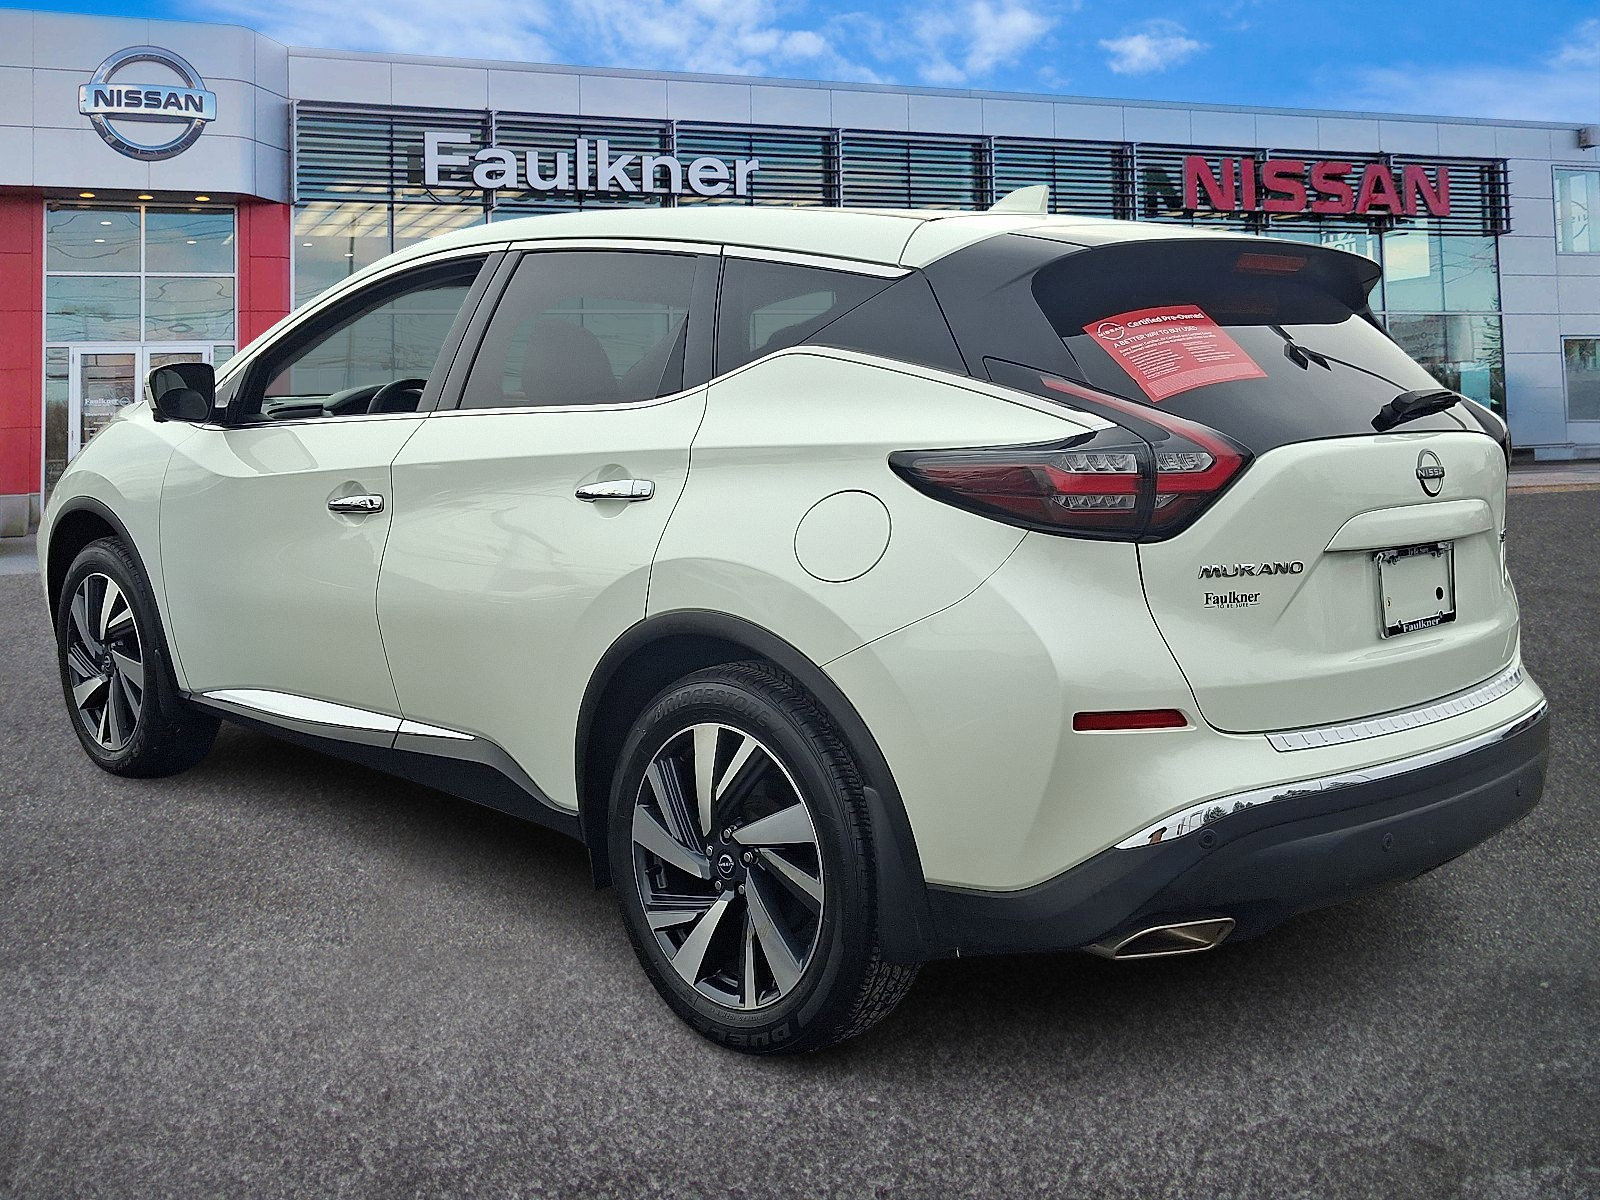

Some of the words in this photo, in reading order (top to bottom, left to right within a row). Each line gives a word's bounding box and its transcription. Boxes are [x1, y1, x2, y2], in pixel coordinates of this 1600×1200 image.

[94, 90, 203, 112] NISSAN
[424, 132, 759, 196] Faulkner
[1184, 155, 1450, 217] NISSAN
[1127, 317, 1162, 328] Certified
[1162, 312, 1205, 322] Pre-Owned
[1119, 334, 1146, 346] BETTER
[1198, 560, 1304, 579] MURANO
[1204, 591, 1261, 605] Faulkner
[1403, 618, 1440, 632] Faulkner
